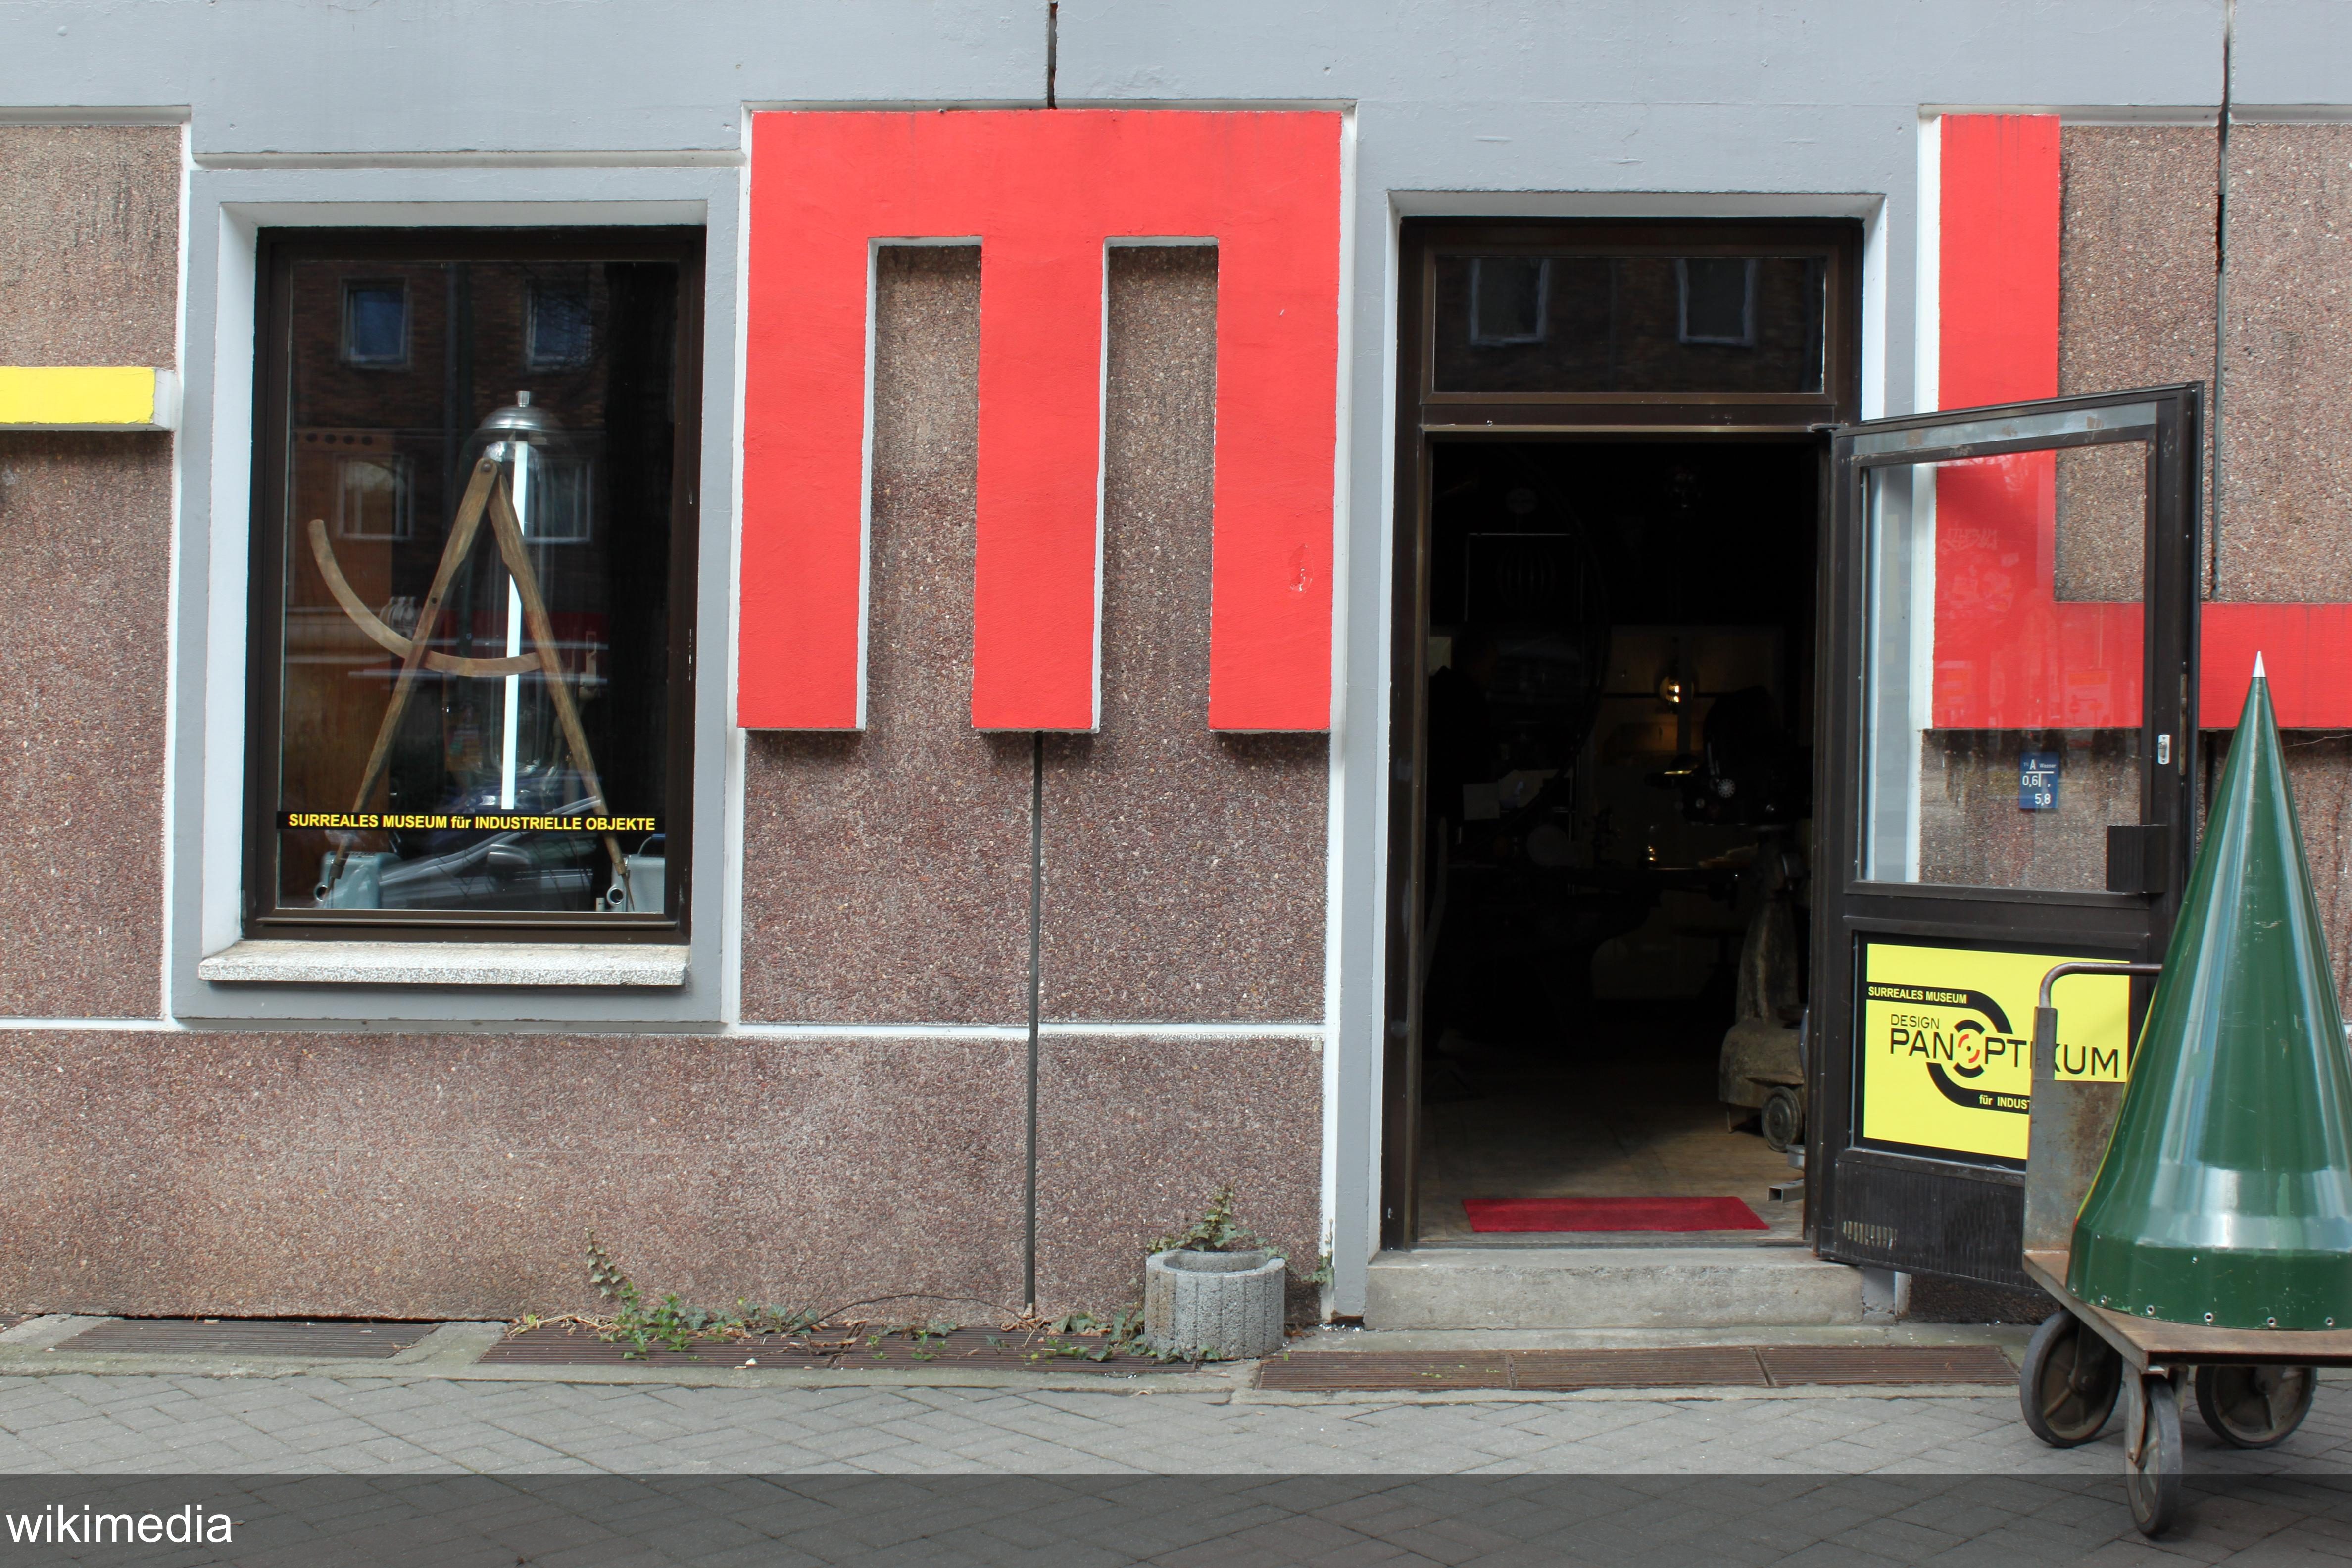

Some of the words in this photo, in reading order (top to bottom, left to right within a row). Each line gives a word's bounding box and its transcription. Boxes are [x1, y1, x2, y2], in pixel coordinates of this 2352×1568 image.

[2035, 793, 2051, 806] 5,8
[289, 814, 378, 827] SURREALES
[383, 815, 447, 828] MUSEUM
[451, 816, 472, 829] für
[475, 816, 582, 830] INDUSTRIELLE
[586, 817, 655, 830] OBJEKTE
[1868, 986, 1923, 1001] SURREALES
[1925, 991, 1967, 1004] MUSEUM
[1891, 1014, 1939, 1029] DESIGN
[1979, 1094, 1993, 1105] für
